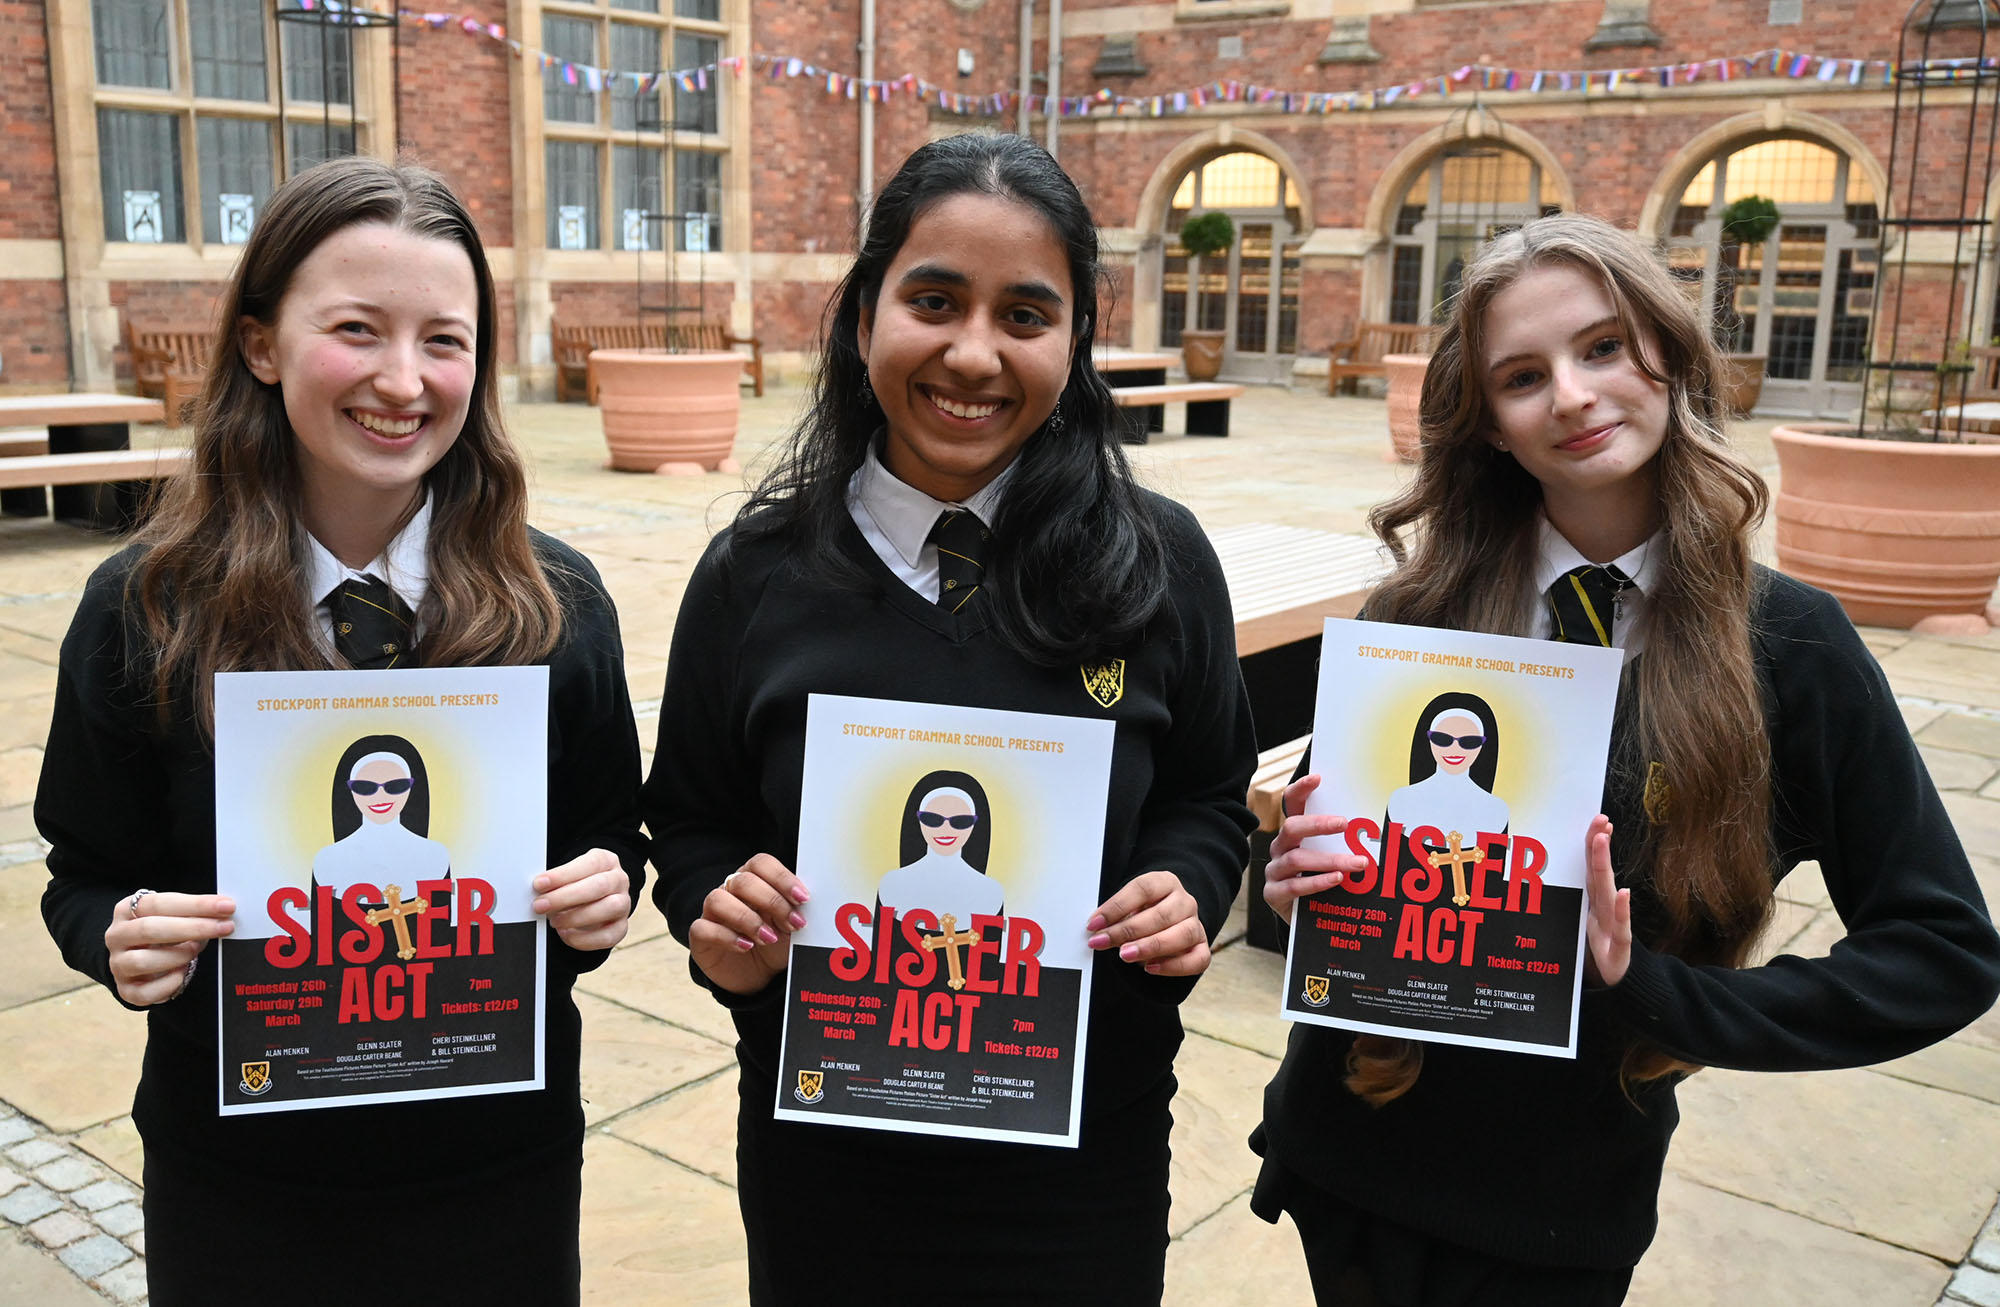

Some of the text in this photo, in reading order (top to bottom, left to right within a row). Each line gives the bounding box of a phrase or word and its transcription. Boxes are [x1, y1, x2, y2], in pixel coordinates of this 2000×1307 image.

[1358, 646, 1575, 680] STOCKPORT GRAMMAR SCHOOL PRESENTS
[257, 694, 499, 711] STOCKPORT GRAMMAR SCHOOL PRESENTS
[843, 723, 1064, 753] STOCKPORT GRAMMAR SCHOOL PRESENTS
[1339, 817, 1547, 915] SISTER
[1310, 901, 1363, 919] Wednesday
[1365, 909, 1386, 922] 26th
[264, 877, 497, 968] SISTER
[1316, 918, 1382, 937] Saturday 29th
[1393, 904, 1484, 966] ACT
[1515, 936, 1536, 948] 7pm
[829, 902, 1044, 997] SISTER
[1330, 936, 1361, 950] March
[1488, 956, 1560, 974] Tickets: £12/£9
[1342, 971, 1365, 980] MENKEN
[236, 982, 298, 995] Wednesday
[302, 980, 326, 991] 26th
[470, 979, 492, 991] 7pm
[1407, 980, 1448, 991] GLENN SLATER
[338, 962, 434, 1024] ACT
[800, 991, 856, 1008] Wednesday
[859, 996, 881, 1008] 26th
[1388, 989, 1410, 997] DOUGLAS
[1494, 990, 1535, 1000] STEINKELLNER
[247, 997, 322, 1011] Saturday 29th
[442, 999, 519, 1014] Tickets: £12/£9
[1480, 999, 1491, 1007] BILL
[1493, 1001, 1534, 1011] STEINKELLNER
[266, 1014, 300, 1027] March
[808, 1008, 876, 1025] Saturday 29th
[888, 989, 981, 1053] ACT
[1013, 1019, 1034, 1032] 7pm
[452, 1033, 495, 1043] STEINKELLNER
[824, 1026, 855, 1040] March
[284, 1047, 309, 1055] MENKEN
[379, 1041, 402, 1049] SLATER
[453, 1044, 496, 1054] STEINKELLNER
[985, 1041, 1059, 1059] Tickets: £12/£9
[385, 1051, 401, 1059] BEANE
[820, 1061, 860, 1071] ALAN MENKEN
[903, 1069, 945, 1079] GLENN SLATER
[973, 1075, 1034, 1087] CHERI STEINKELLNER
[884, 1078, 908, 1087] DOUGLAS
[978, 1087, 990, 1095] BILL
[992, 1088, 1034, 1099] STEINKELLNER
